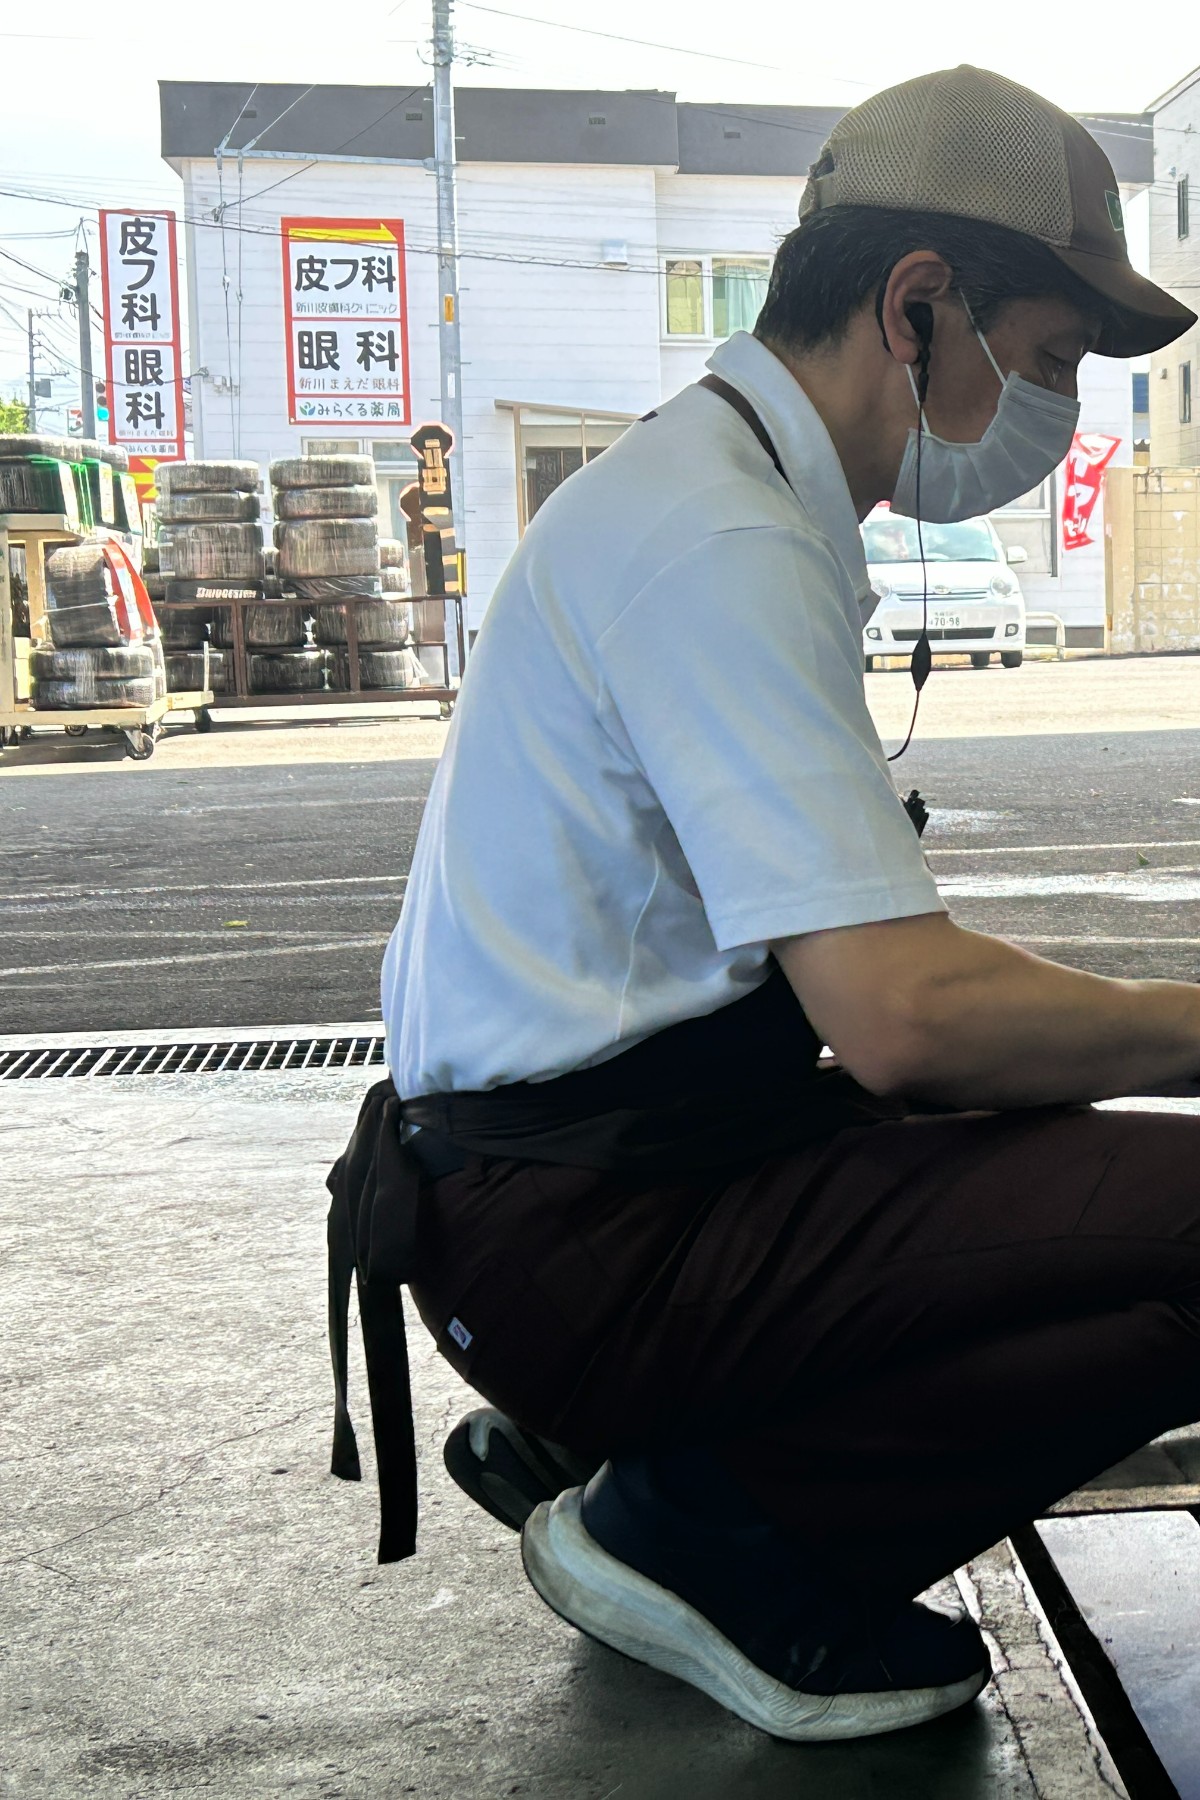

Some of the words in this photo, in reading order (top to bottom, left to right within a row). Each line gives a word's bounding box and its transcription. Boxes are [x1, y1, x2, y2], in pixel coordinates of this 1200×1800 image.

[119, 217, 161, 331] 皮フ科
[295, 255, 396, 293] 皮フ科
[298, 330, 399, 372] 眼科
[125, 349, 165, 430] 眼科
[317, 401, 400, 417] みらくる薬局
